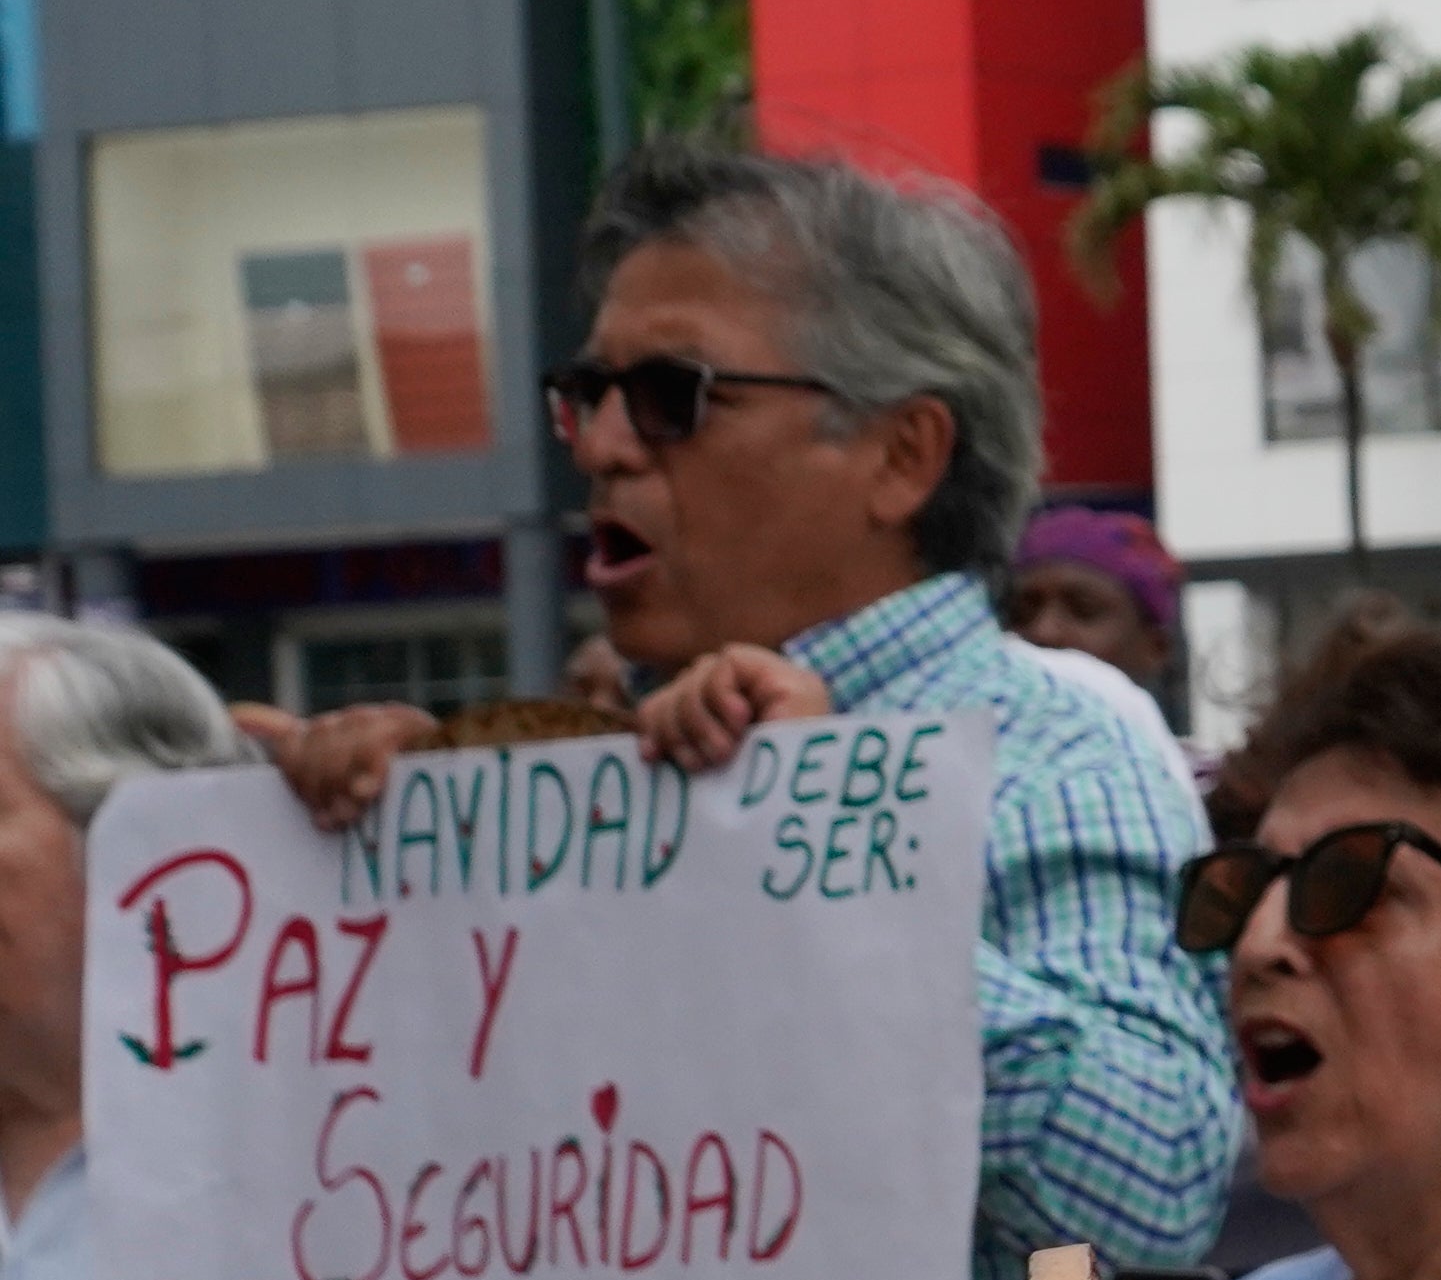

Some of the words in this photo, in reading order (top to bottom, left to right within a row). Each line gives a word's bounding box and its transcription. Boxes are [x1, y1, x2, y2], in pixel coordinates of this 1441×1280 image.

[738, 725, 944, 811] DEBE
[760, 809, 920, 901] SER:
[116, 849, 390, 1071] PAZ
[472, 925, 520, 1081] Y
